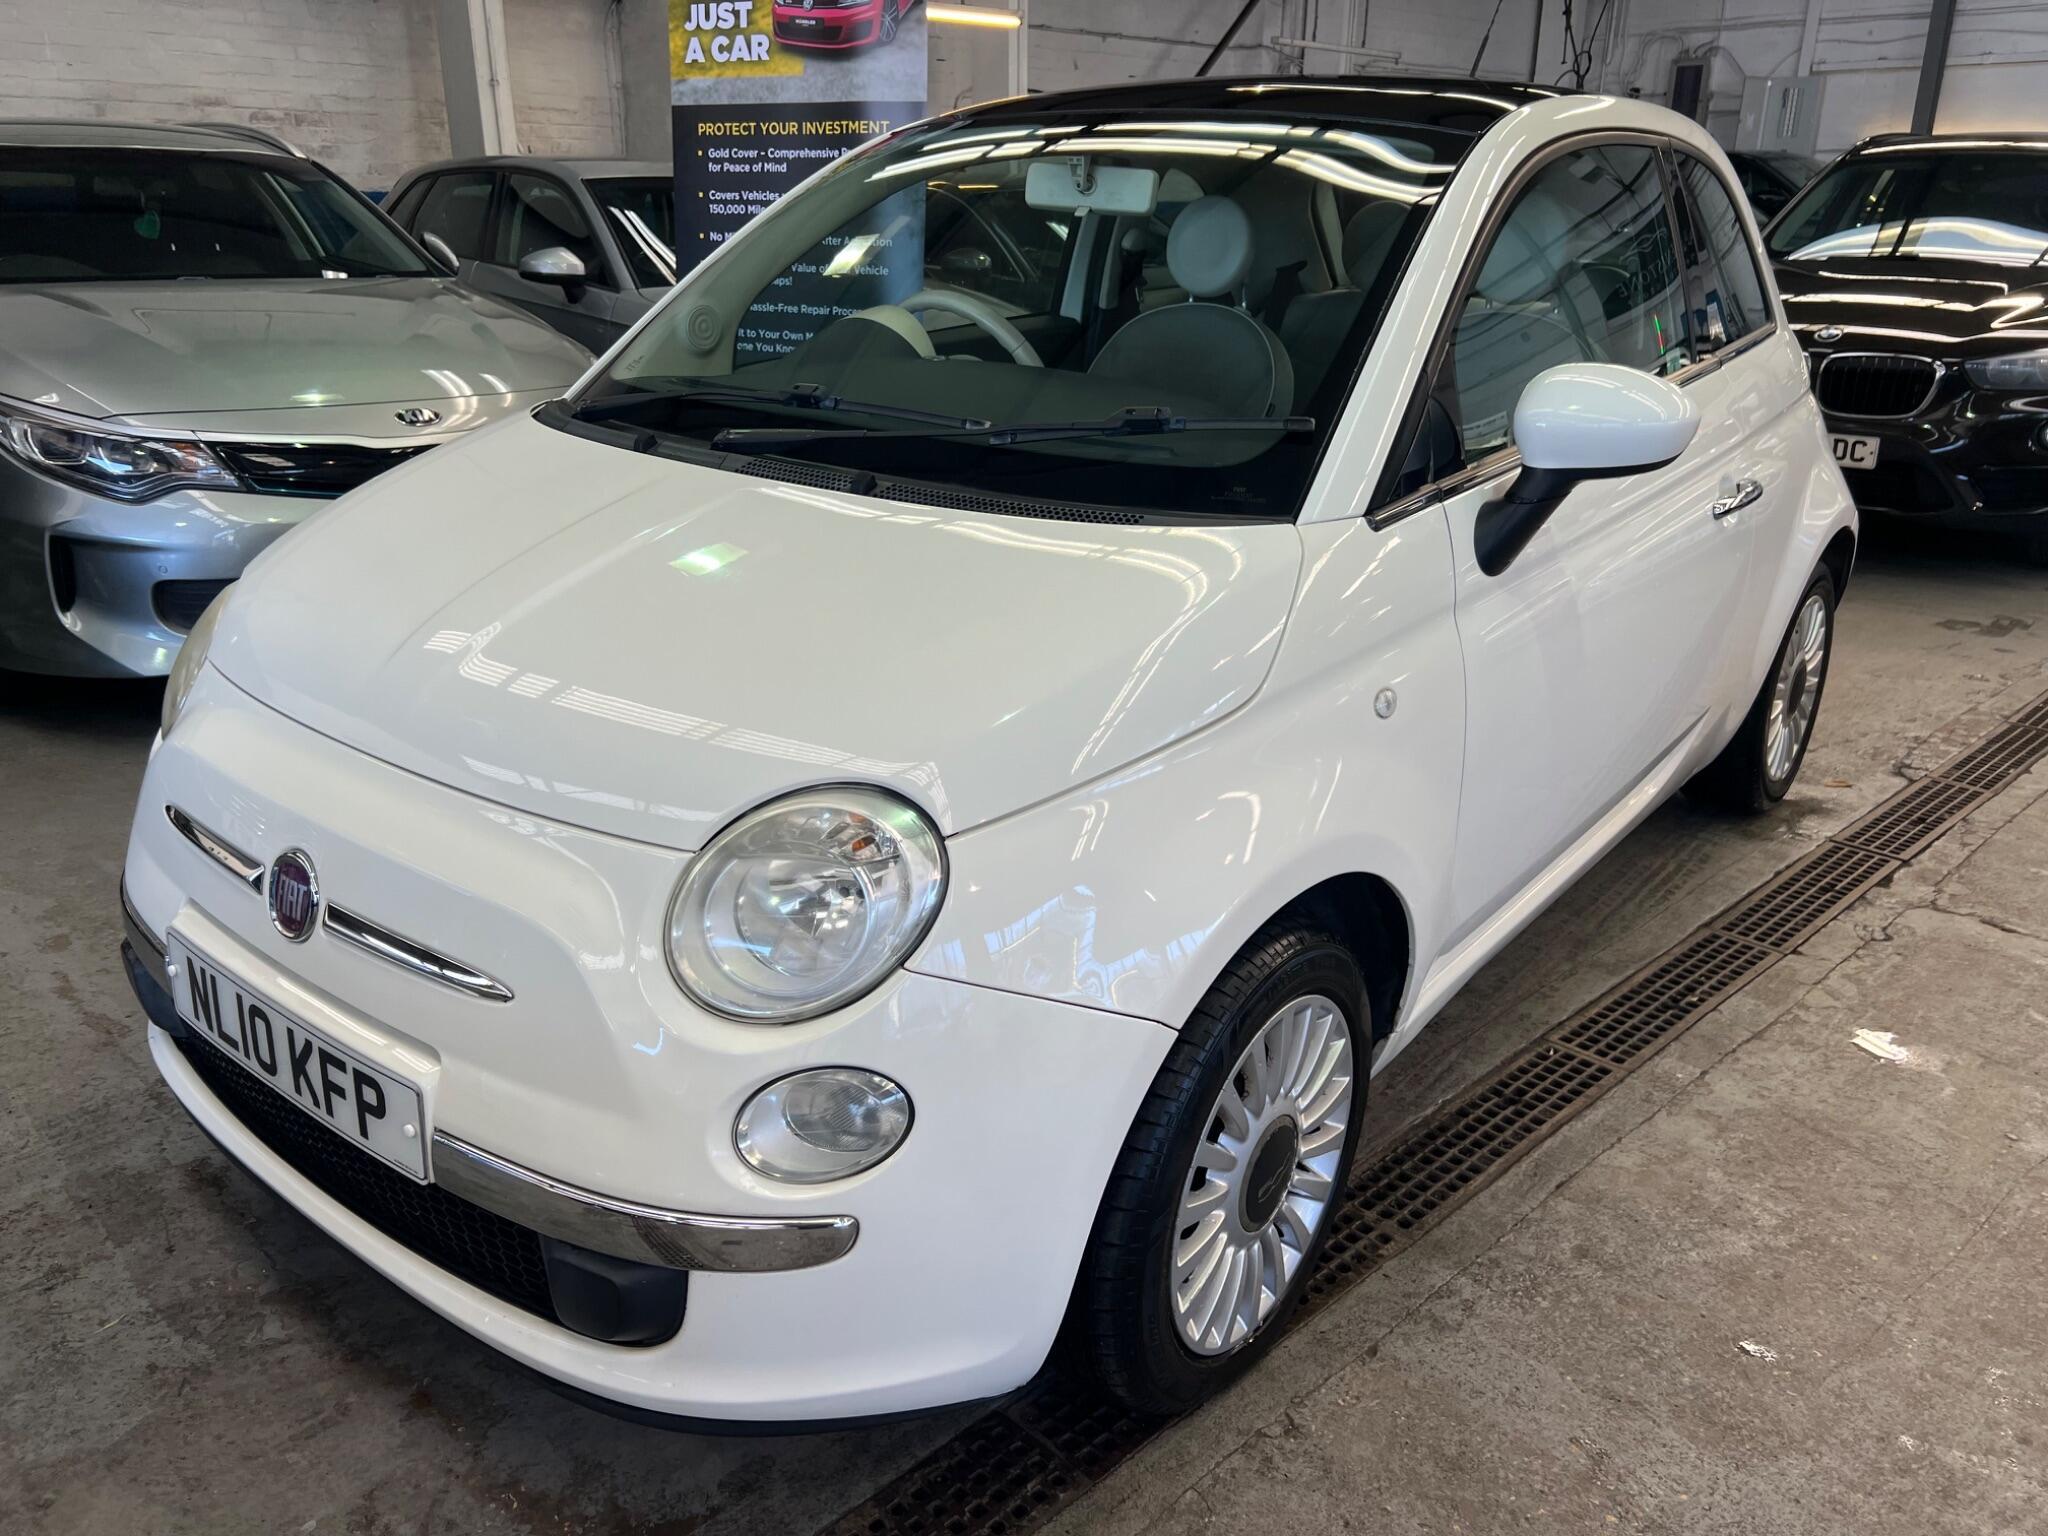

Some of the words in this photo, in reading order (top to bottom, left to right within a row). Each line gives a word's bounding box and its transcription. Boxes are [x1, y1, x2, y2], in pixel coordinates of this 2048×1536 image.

[684, 1, 753, 31] JUST
[684, 37, 706, 63] A
[711, 34, 770, 63] CAR
[698, 122, 757, 136] PROTECT
[760, 122, 798, 135] YOUR
[802, 120, 890, 135] INVESTMENT
[708, 148, 729, 158] Gold
[731, 148, 758, 158] Cover
[768, 148, 840, 160] Comprehensive
[708, 162, 721, 172] for
[723, 163, 751, 172] Peace
[752, 162, 763, 172] of
[764, 162, 787, 172] Mind
[709, 190, 740, 200] Covers
[741, 190, 780, 201] Vehicles
[709, 204, 746, 215] 150,000
[709, 232, 722, 241] No
[791, 263, 816, 273] Value
[854, 265, 890, 275] Vehicle
[750, 302, 799, 314] assle-Free
[801, 304, 831, 316] Repair
[746, 329, 757, 338] to
[759, 329, 780, 339] Your
[782, 330, 804, 340] Own
[756, 342, 774, 352] You
[1833, 438, 1868, 463] DC
[279, 872, 308, 921] FIAT
[186, 956, 278, 1078] NL10
[286, 1026, 388, 1141] KFP
